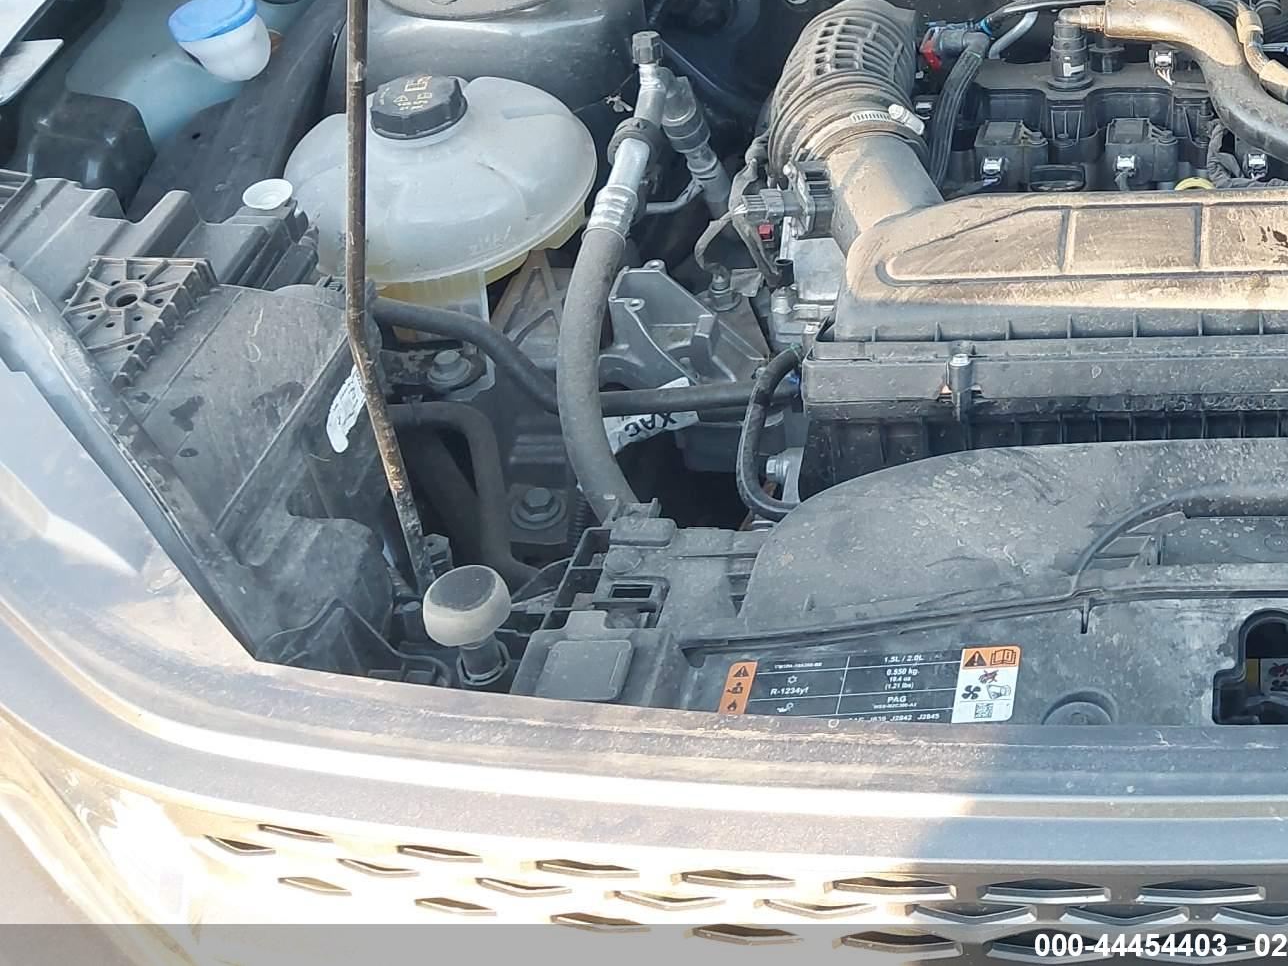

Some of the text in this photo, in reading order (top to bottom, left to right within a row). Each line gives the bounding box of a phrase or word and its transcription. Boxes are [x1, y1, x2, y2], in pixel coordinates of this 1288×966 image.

[906, 654, 924, 662] 2.0L
[886, 667, 918, 676] 0.550 kg
[770, 686, 809, 696] R-1234yf
[887, 695, 907, 704] PAG
